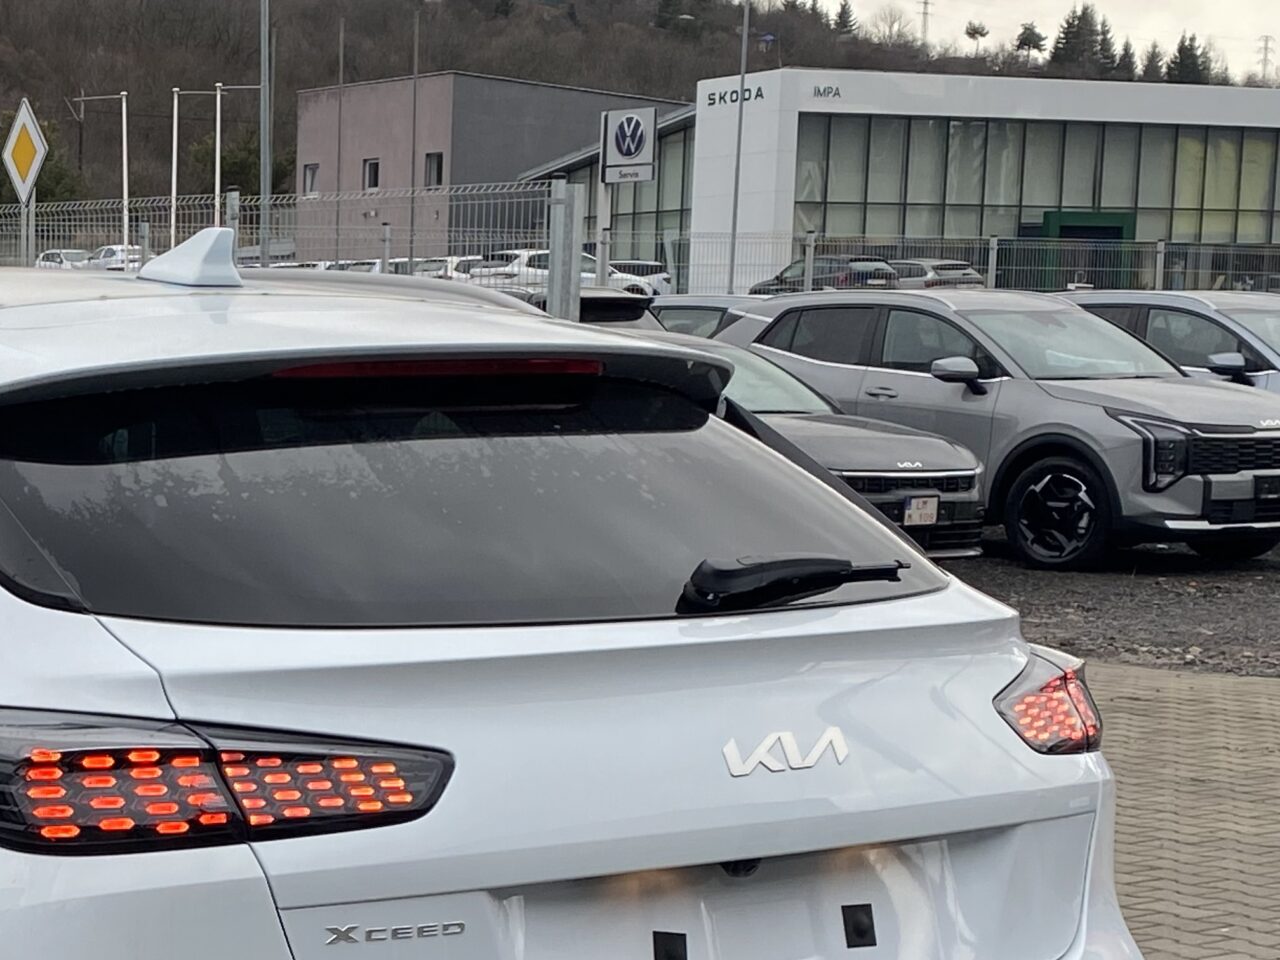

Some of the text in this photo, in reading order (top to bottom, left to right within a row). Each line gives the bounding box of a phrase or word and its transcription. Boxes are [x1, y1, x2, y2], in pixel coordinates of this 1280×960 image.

[813, 85, 842, 98] IMPA
[722, 726, 849, 777] KIA
[325, 920, 466, 946] XCEED
